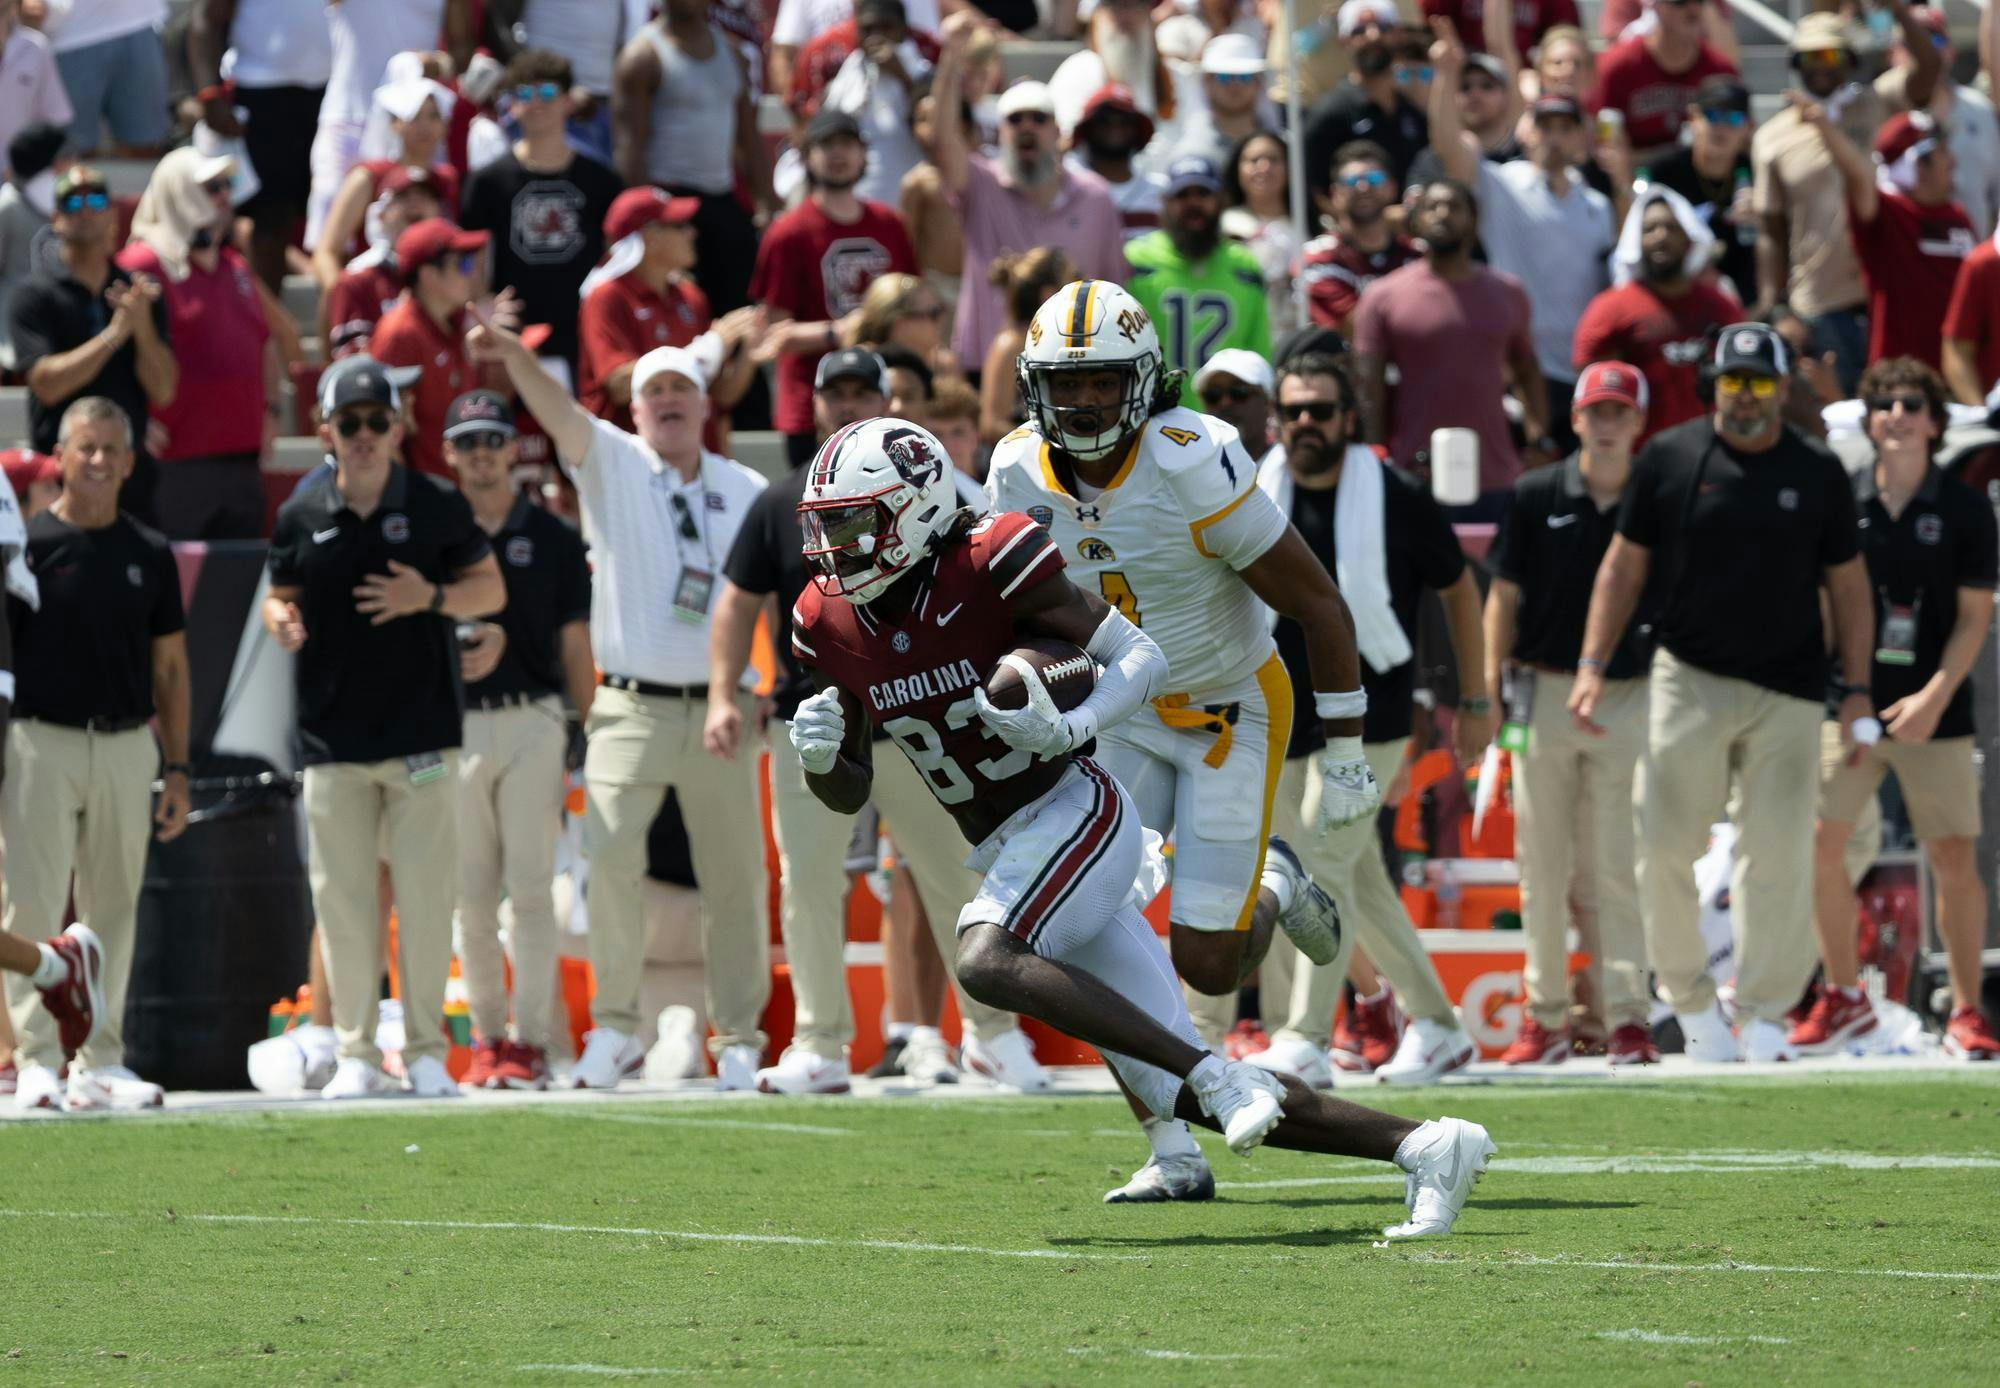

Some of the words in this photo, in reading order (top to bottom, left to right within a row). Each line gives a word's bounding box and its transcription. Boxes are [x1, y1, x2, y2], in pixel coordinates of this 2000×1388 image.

[1162, 288, 1232, 369] 12
[1160, 425, 1201, 447] 4
[1088, 544, 1105, 559] K
[1099, 571, 1142, 628] 4
[868, 658, 981, 711] CAROLINA
[882, 697, 1032, 805] 83
